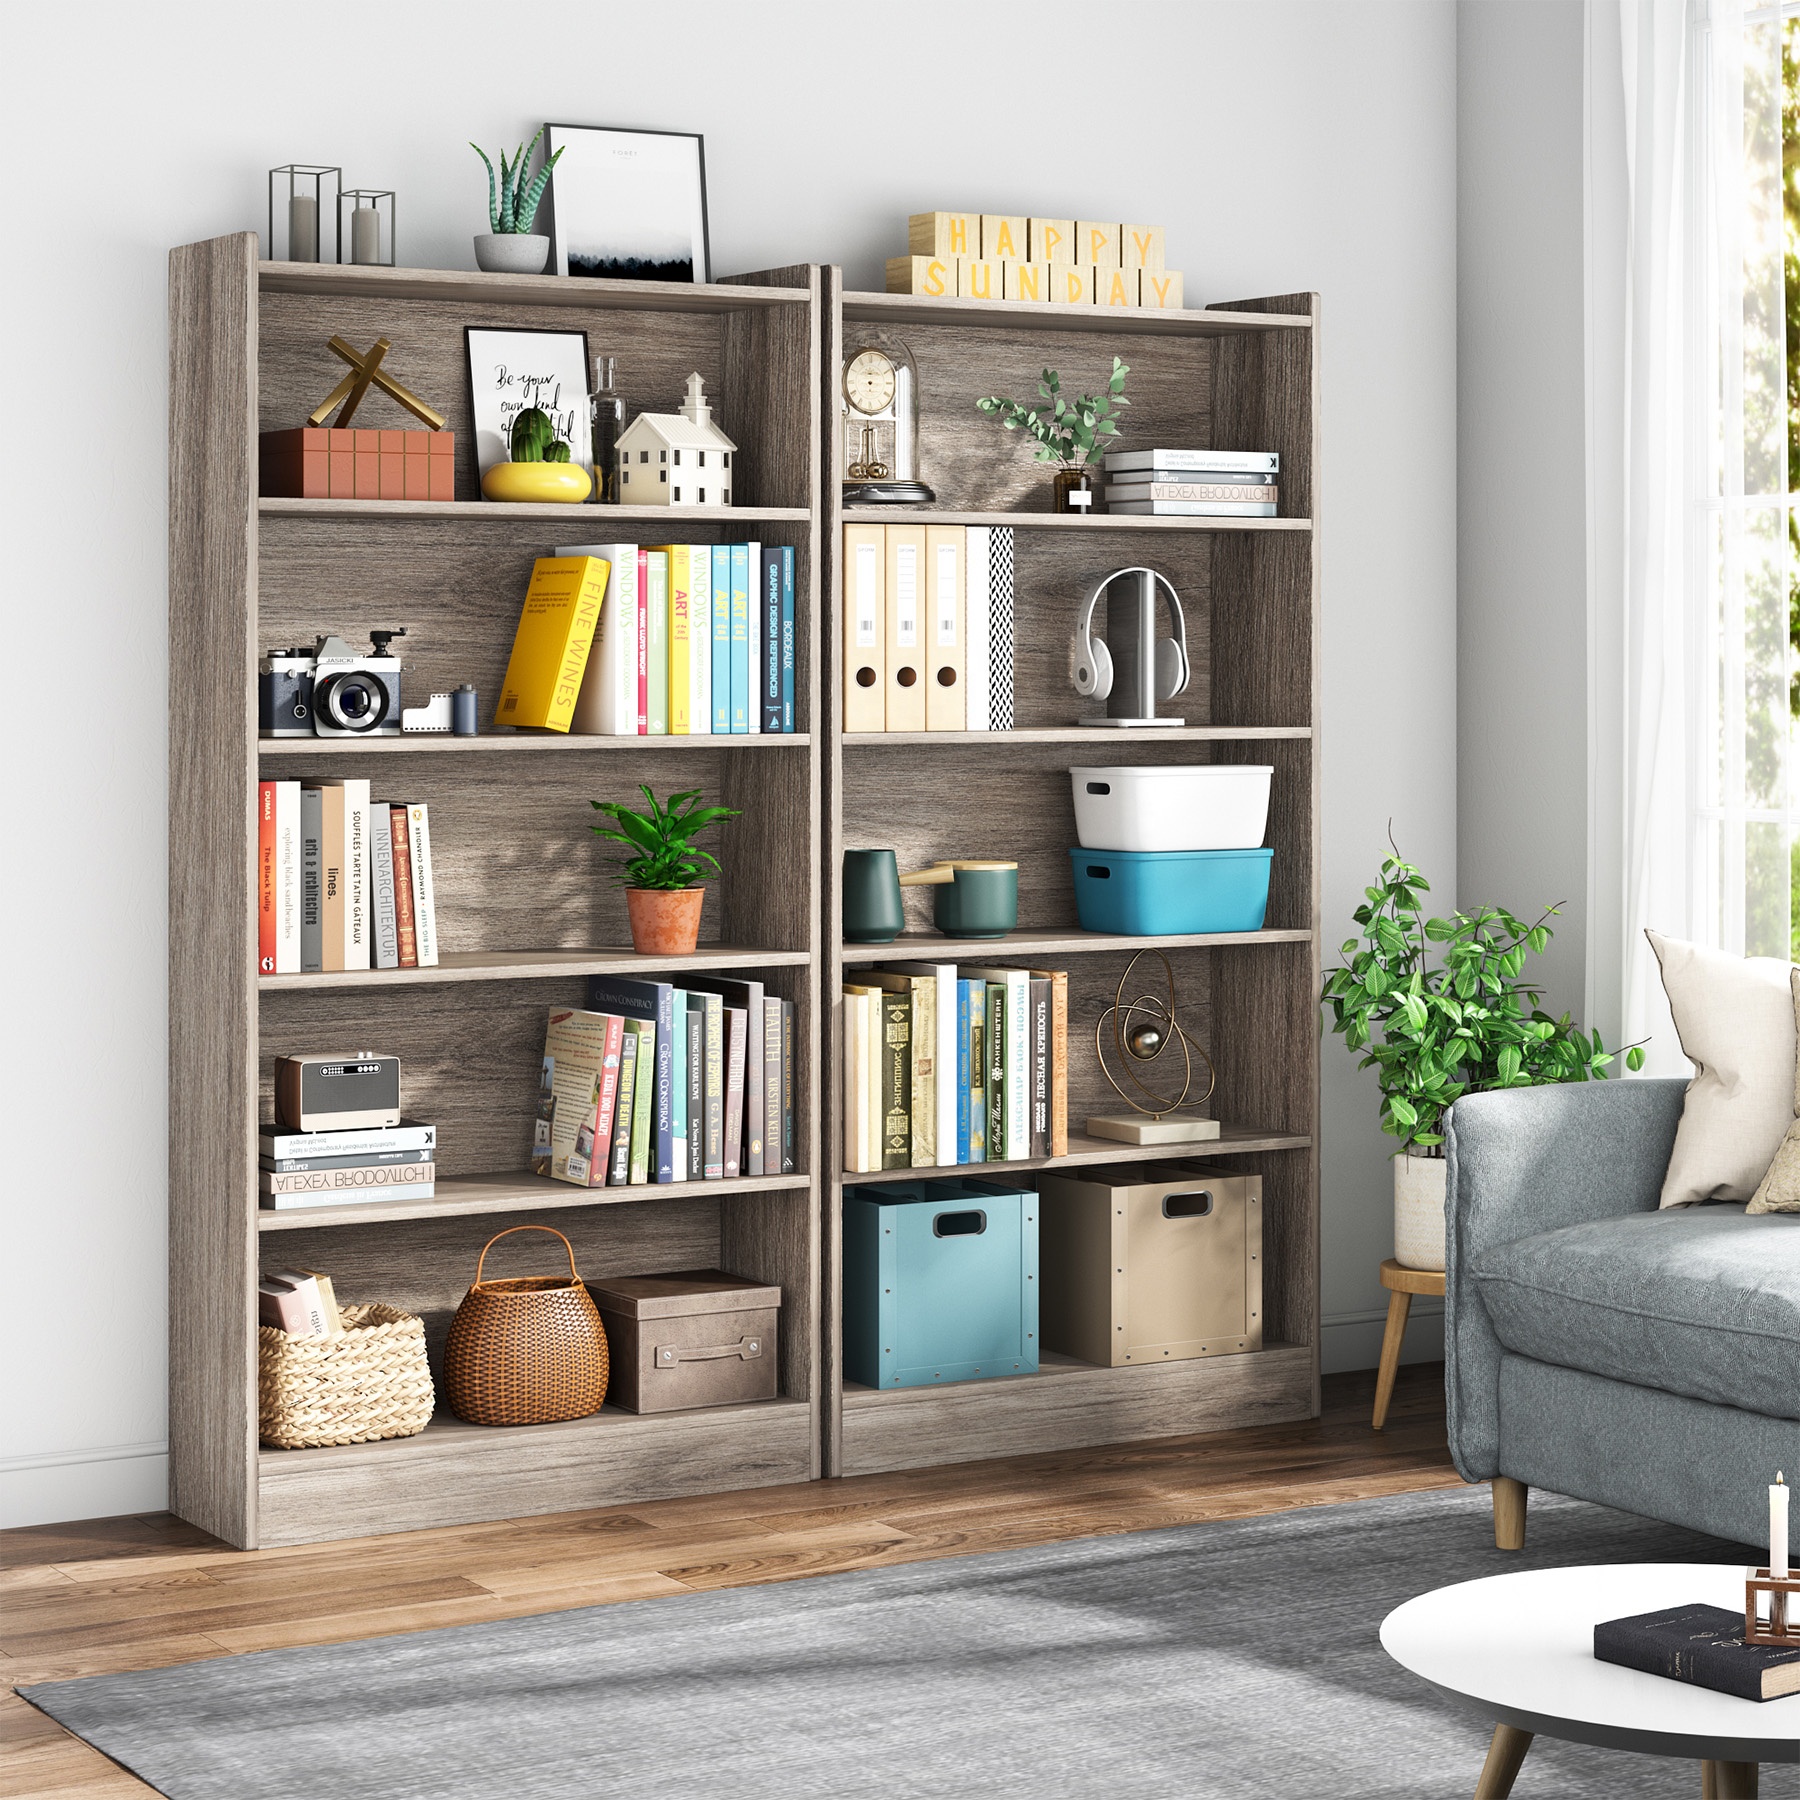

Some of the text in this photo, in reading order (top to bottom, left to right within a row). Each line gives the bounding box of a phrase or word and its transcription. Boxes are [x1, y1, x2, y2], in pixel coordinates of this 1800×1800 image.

[950, 219, 1152, 267] HAPPY
[922, 261, 1171, 308] SUNDAY
[494, 364, 555, 398] Be your
[501, 383, 561, 412] own kind
[501, 414, 514, 449] of
[620, 551, 634, 628] WINDOWS
[693, 551, 707, 628] WINDOWS
[769, 564, 778, 603] GRAPHIC
[576, 581, 601, 630] FINE
[675, 589, 688, 619] ART
[715, 589, 729, 620] ART
[733, 589, 747, 620] ART
[769, 606, 778, 638] DESIGN
[783, 620, 792, 669] BORDEAUX
[557, 639, 588, 708] WINES
[769, 640, 778, 698] REFERENCED
[305, 838, 318, 857] arts
[353, 811, 362, 851] SOUFFLÉS
[415, 826, 423, 863] CHANDLER
[282, 827, 293, 939] exploring black sand beaches
[327, 868, 339, 900] lines.
[353, 852, 361, 878] TARTE
[417, 864, 426, 900] RAYMOND
[263, 890, 271, 912] Tulip
[305, 870, 319, 925] architecture
[353, 879, 361, 904] TATIN
[376, 828, 396, 958] INNENARCHITEKTUR
[420, 909, 428, 928] SLEEP
[708, 999, 721, 1097] THE PROPHECY OF ZEPHYRUS
[729, 1017, 745, 1092] GEOSYNCHRON
[1015, 984, 1025, 1144] АЛЕКСАНДР БЛОК ПОЭМЫ
[1037, 1001, 1046, 1099] ЛЕСНАЯ КРЕПОСТЬ
[622, 1059, 633, 1092] DUNGEON
[659, 1043, 670, 1132] CROWN CONSPIRACY
[766, 1006, 781, 1148] HALITH KIRSTEN KELLY
[598, 1073, 615, 1137] KEDAI 1001 MIMPI
[618, 1104, 631, 1127] DEATH
[621, 1093, 631, 1103] OF
[616, 1147, 628, 1163] Scott
[710, 1129, 719, 1155] Hesse
